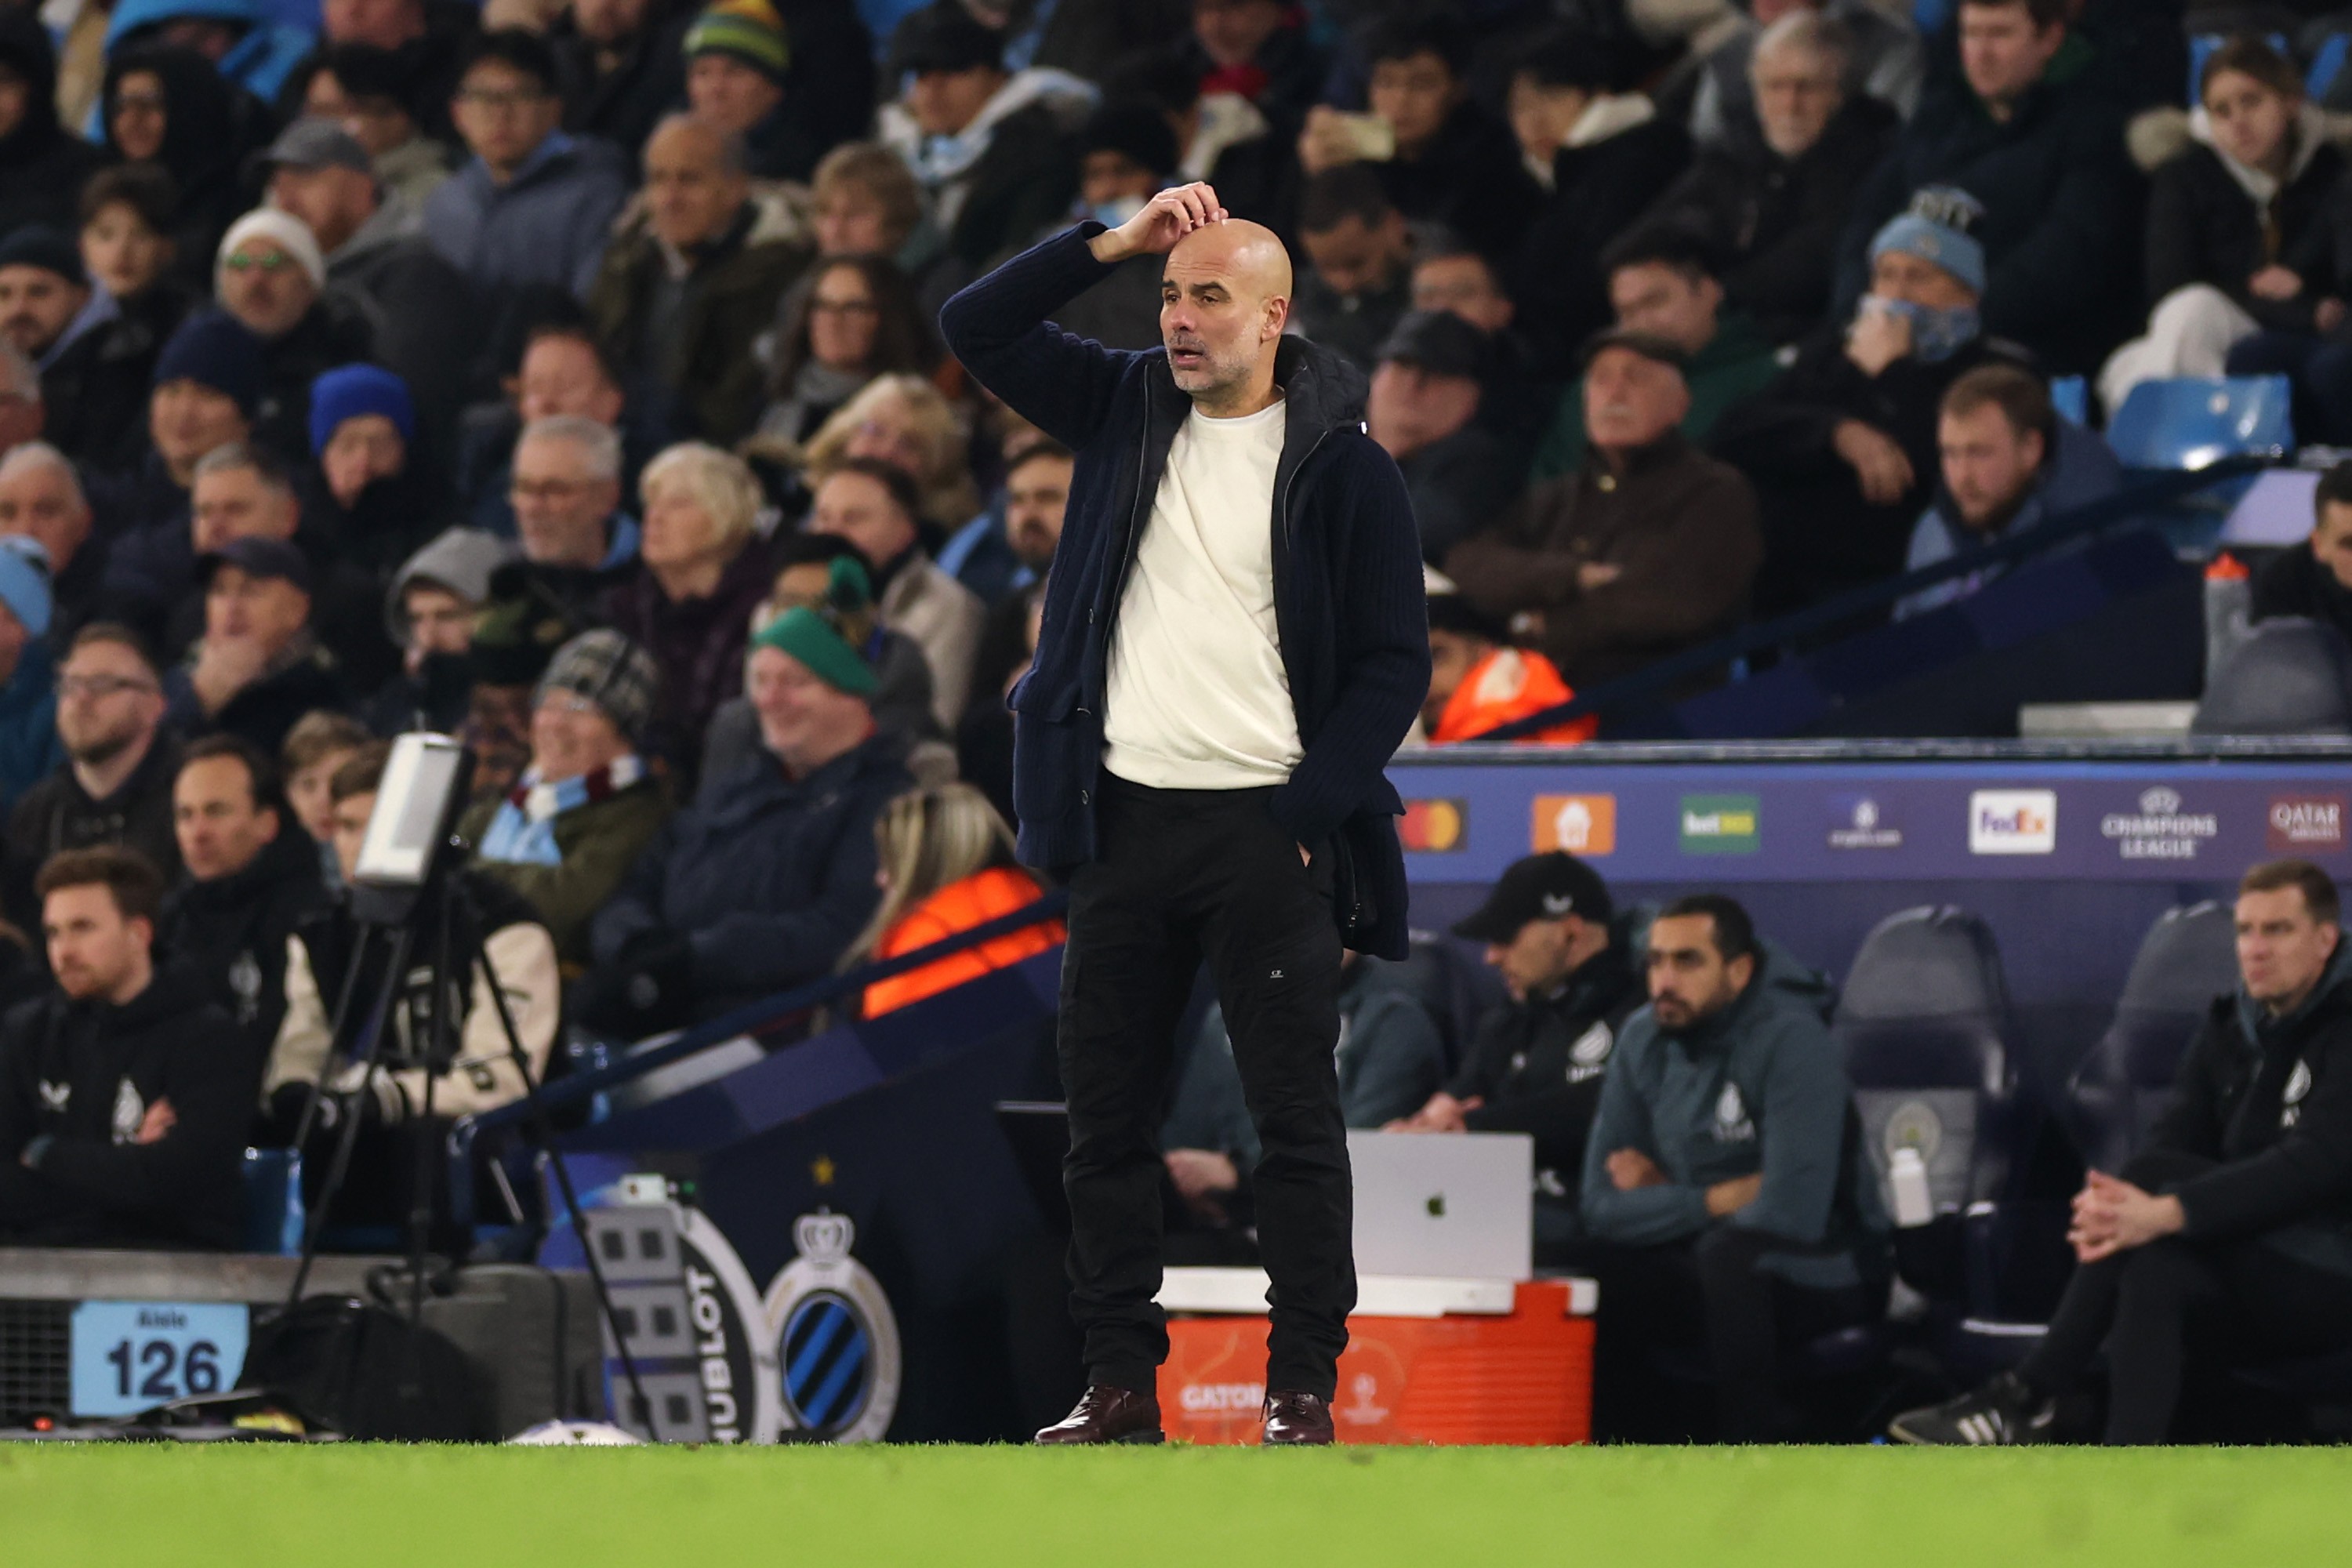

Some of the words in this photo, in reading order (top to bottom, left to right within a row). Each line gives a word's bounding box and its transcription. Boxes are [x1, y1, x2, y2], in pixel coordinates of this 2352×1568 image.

[1982, 809, 2045, 833] FedEx
[2101, 814, 2218, 837] CHAMPIONS
[2270, 803, 2339, 829] QATAR
[2120, 838, 2195, 858] LEAGUE
[107, 1340, 219, 1397] 126
